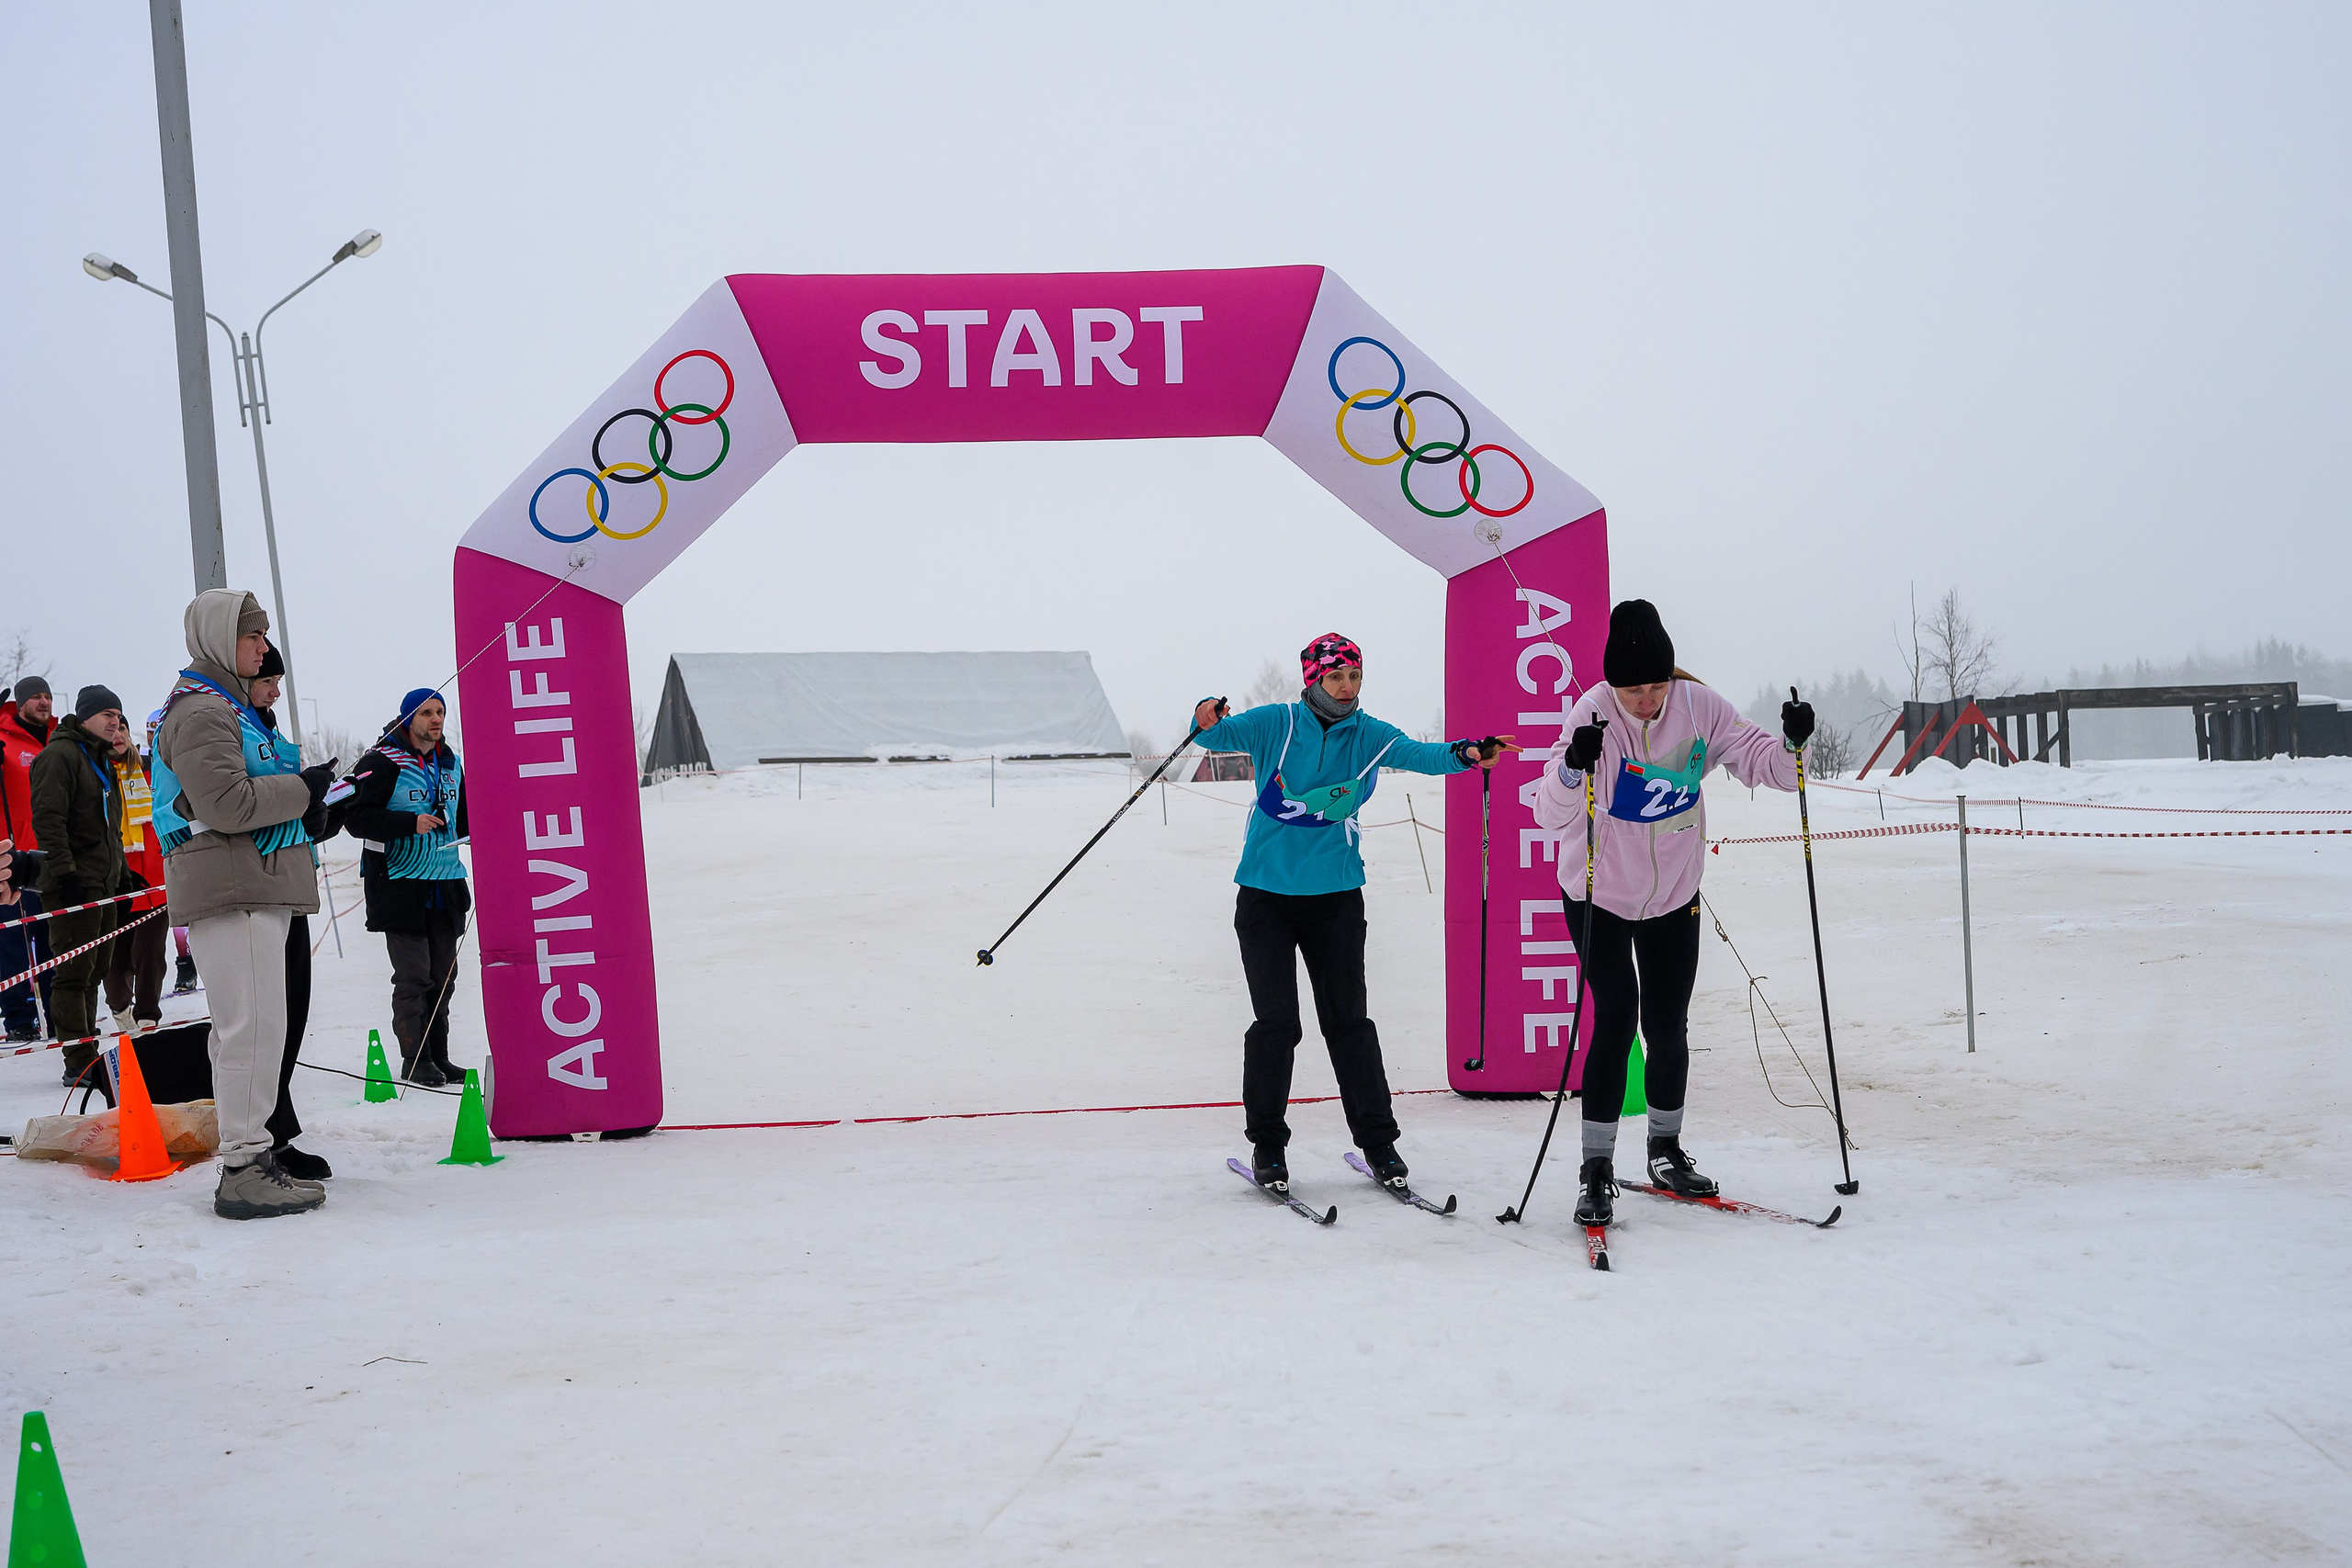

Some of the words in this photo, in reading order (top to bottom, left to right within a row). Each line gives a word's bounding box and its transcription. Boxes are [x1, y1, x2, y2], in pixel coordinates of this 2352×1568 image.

[859, 306, 1204, 389] START
[504, 617, 578, 779] LIFE
[409, 789, 457, 803] СУЬЯ
[1640, 778, 1689, 817] 2.2
[523, 806, 608, 1091] ACTIVE
[1520, 899, 1579, 1054] LIFE
